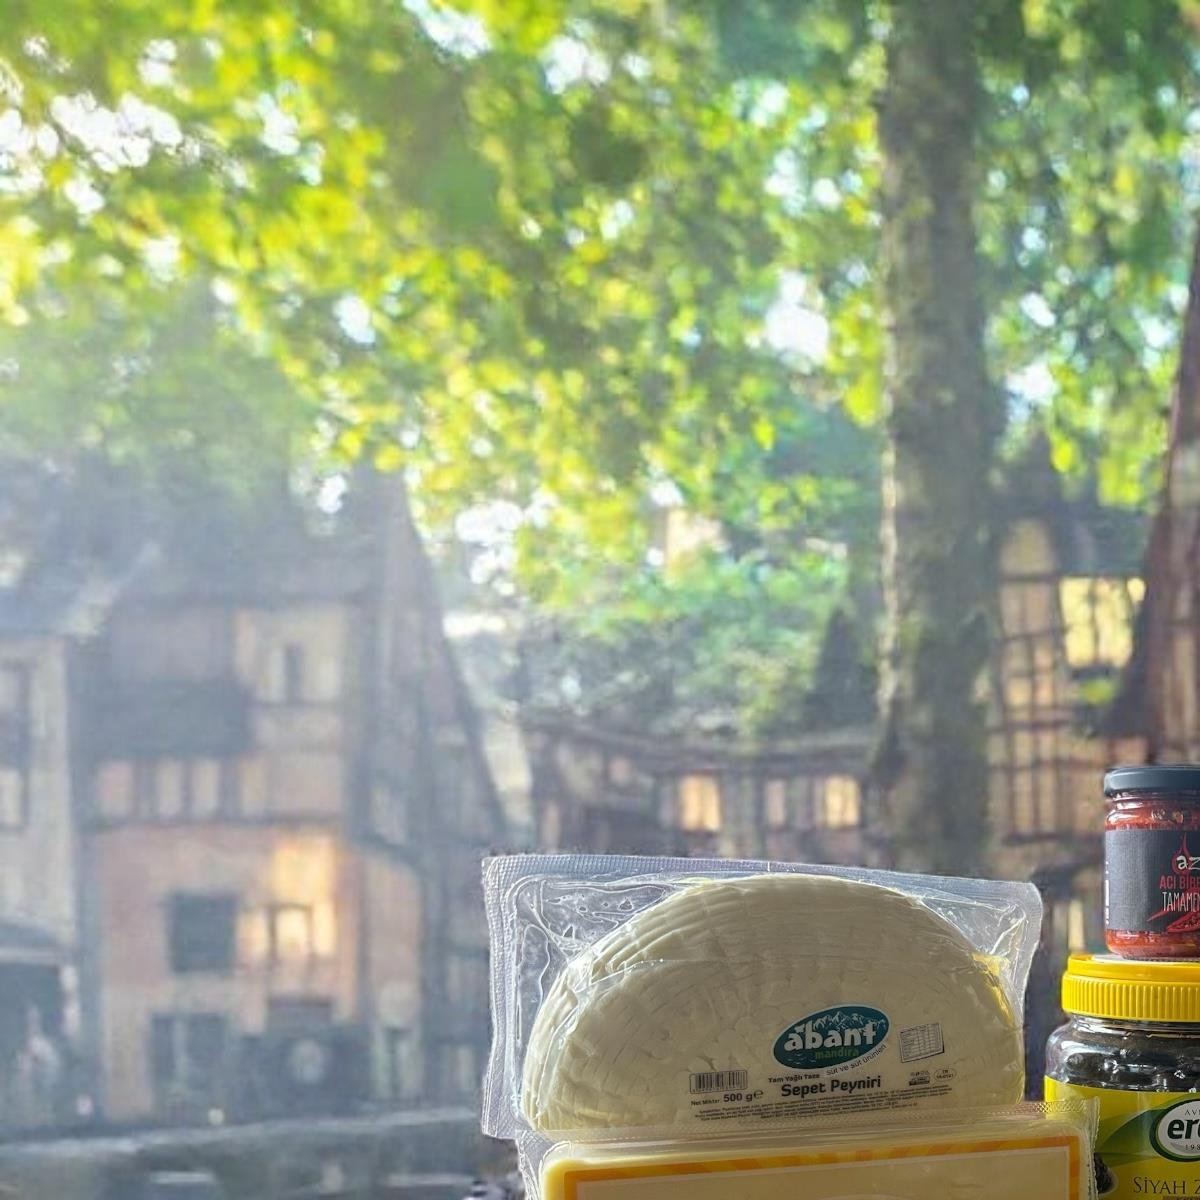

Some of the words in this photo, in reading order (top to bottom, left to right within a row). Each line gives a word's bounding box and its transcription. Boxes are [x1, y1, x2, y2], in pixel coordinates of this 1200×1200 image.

[1160, 875, 1176, 889] ACI
[781, 1082, 827, 1098] Sepet
[831, 1076, 881, 1093] Peyniri
[723, 1092, 743, 1102] 500
[1133, 1175, 1186, 1195] SİYAH
